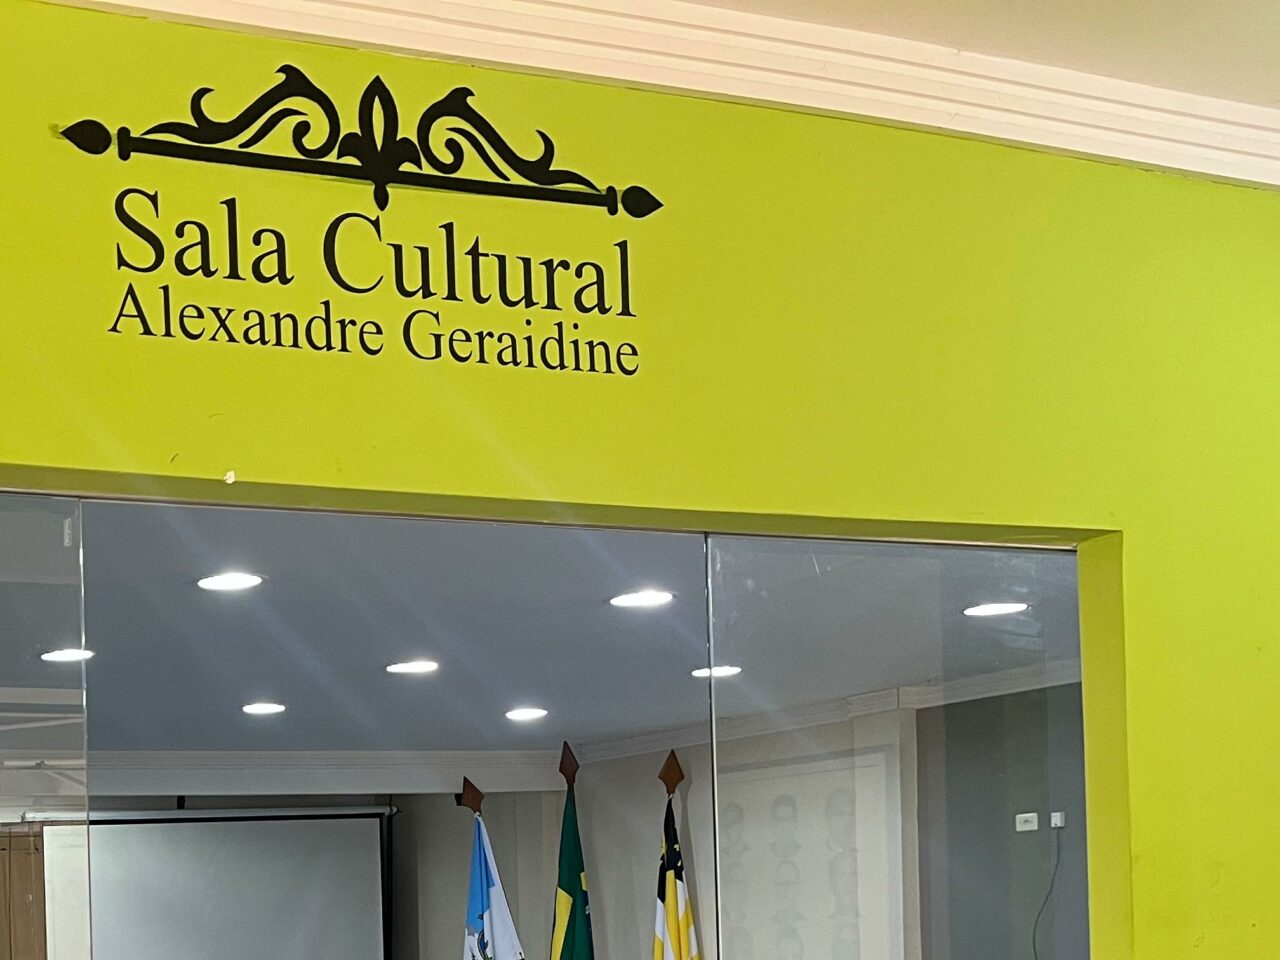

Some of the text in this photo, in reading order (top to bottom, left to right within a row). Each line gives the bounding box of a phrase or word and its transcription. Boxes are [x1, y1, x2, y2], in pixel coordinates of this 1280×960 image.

[114, 188, 637, 318] Sala Cultural
[108, 282, 640, 376] Alexandre Geraidine
